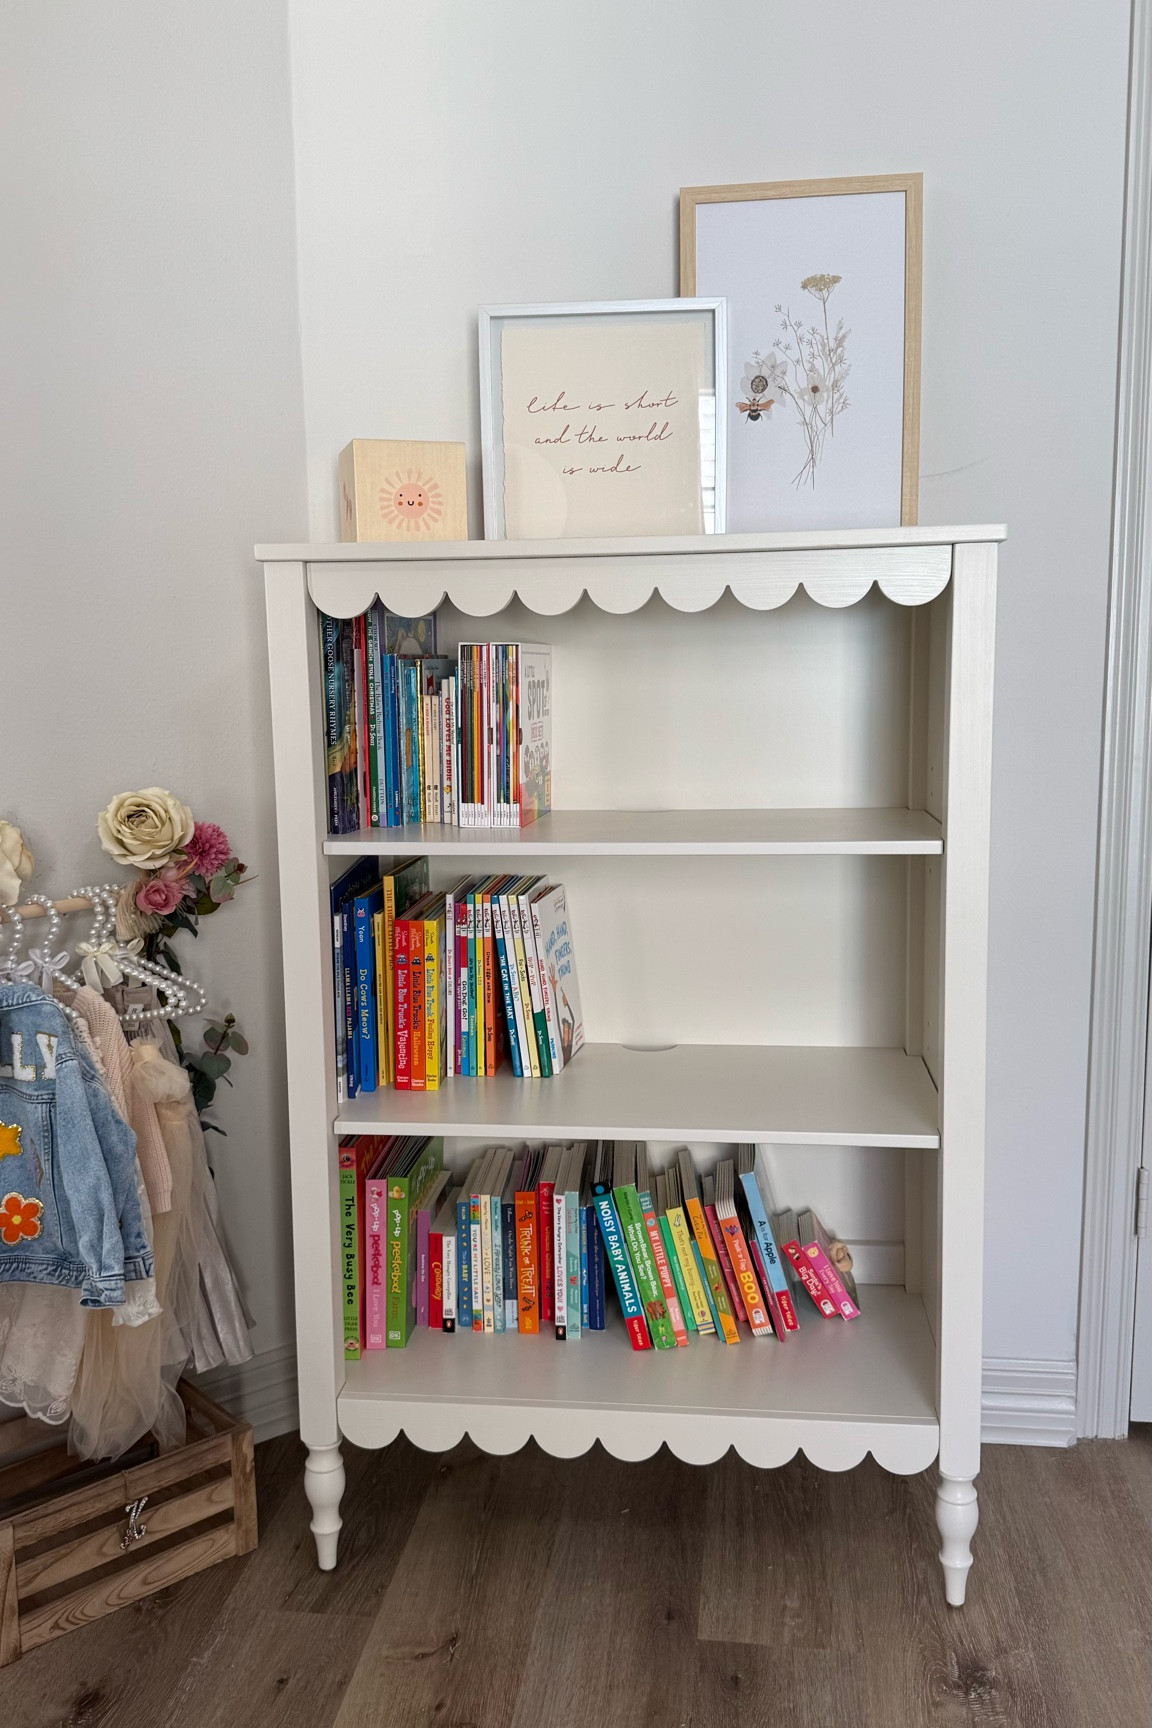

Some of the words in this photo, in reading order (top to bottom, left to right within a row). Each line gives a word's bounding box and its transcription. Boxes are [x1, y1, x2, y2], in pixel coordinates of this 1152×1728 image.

[527, 392, 580, 413] life
[588, 402, 615, 411] is
[625, 390, 679, 410] short
[535, 424, 570, 444] and
[575, 425, 608, 443] the
[617, 422, 673, 441] world
[563, 466, 583, 475] is
[589, 454, 641, 474] wide
[328, 673, 336, 711] NURSERY
[528, 680, 545, 720] SPOT
[446, 745, 451, 757] Me
[360, 969, 367, 980] Do
[398, 970, 407, 987] Little
[413, 971, 421, 988] Little
[426, 969, 434, 984] Little
[398, 989, 407, 1002] Blue
[413, 990, 421, 1003] Blue
[399, 1003, 407, 1028] Truck's
[413, 1005, 421, 1030] Truck's
[506, 1006, 514, 1019] HAT
[361, 1009, 370, 1039] Meow?
[0, 1032, 58, 1081] LY
[397, 1030, 408, 1069] Valentine
[345, 1196, 355, 1217] The
[343, 1224, 355, 1248] Very
[520, 1224, 532, 1255] TRUNK
[627, 1225, 635, 1240] What
[650, 1230, 659, 1241] MY
[599, 1201, 616, 1232] NOISY
[608, 1234, 623, 1261] BABY
[616, 1264, 636, 1313] ANIMALS
[632, 1241, 638, 1252] Do
[652, 1242, 665, 1264] LITTLE
[765, 1242, 776, 1264] Apple
[344, 1253, 355, 1280] Busy
[369, 1234, 382, 1285] peekaboo!
[390, 1241, 402, 1293] peekaboo!
[473, 1253, 478, 1264] MY
[634, 1252, 642, 1264] You
[635, 1222, 644, 1244] Brown
[640, 1243, 648, 1260] Bear,
[644, 1260, 653, 1280] Brown
[650, 1280, 658, 1297] Bear,
[683, 1258, 689, 1268] my
[432, 1262, 442, 1300] CORDUROY
[520, 1264, 535, 1297] TREAT
[638, 1265, 646, 1280] See?
[659, 1266, 672, 1287] PUPPY
[799, 1266, 809, 1280] Big
[806, 1279, 821, 1297] Day!
[808, 1268, 821, 1290] Santa's
[825, 1267, 835, 1281] Love
[834, 1280, 842, 1292] You
[347, 1285, 355, 1304] Bee
[740, 1271, 758, 1304] BOO
[372, 1294, 380, 1311] Love
[785, 1311, 793, 1326] tales
[389, 1331, 400, 1339] DK
